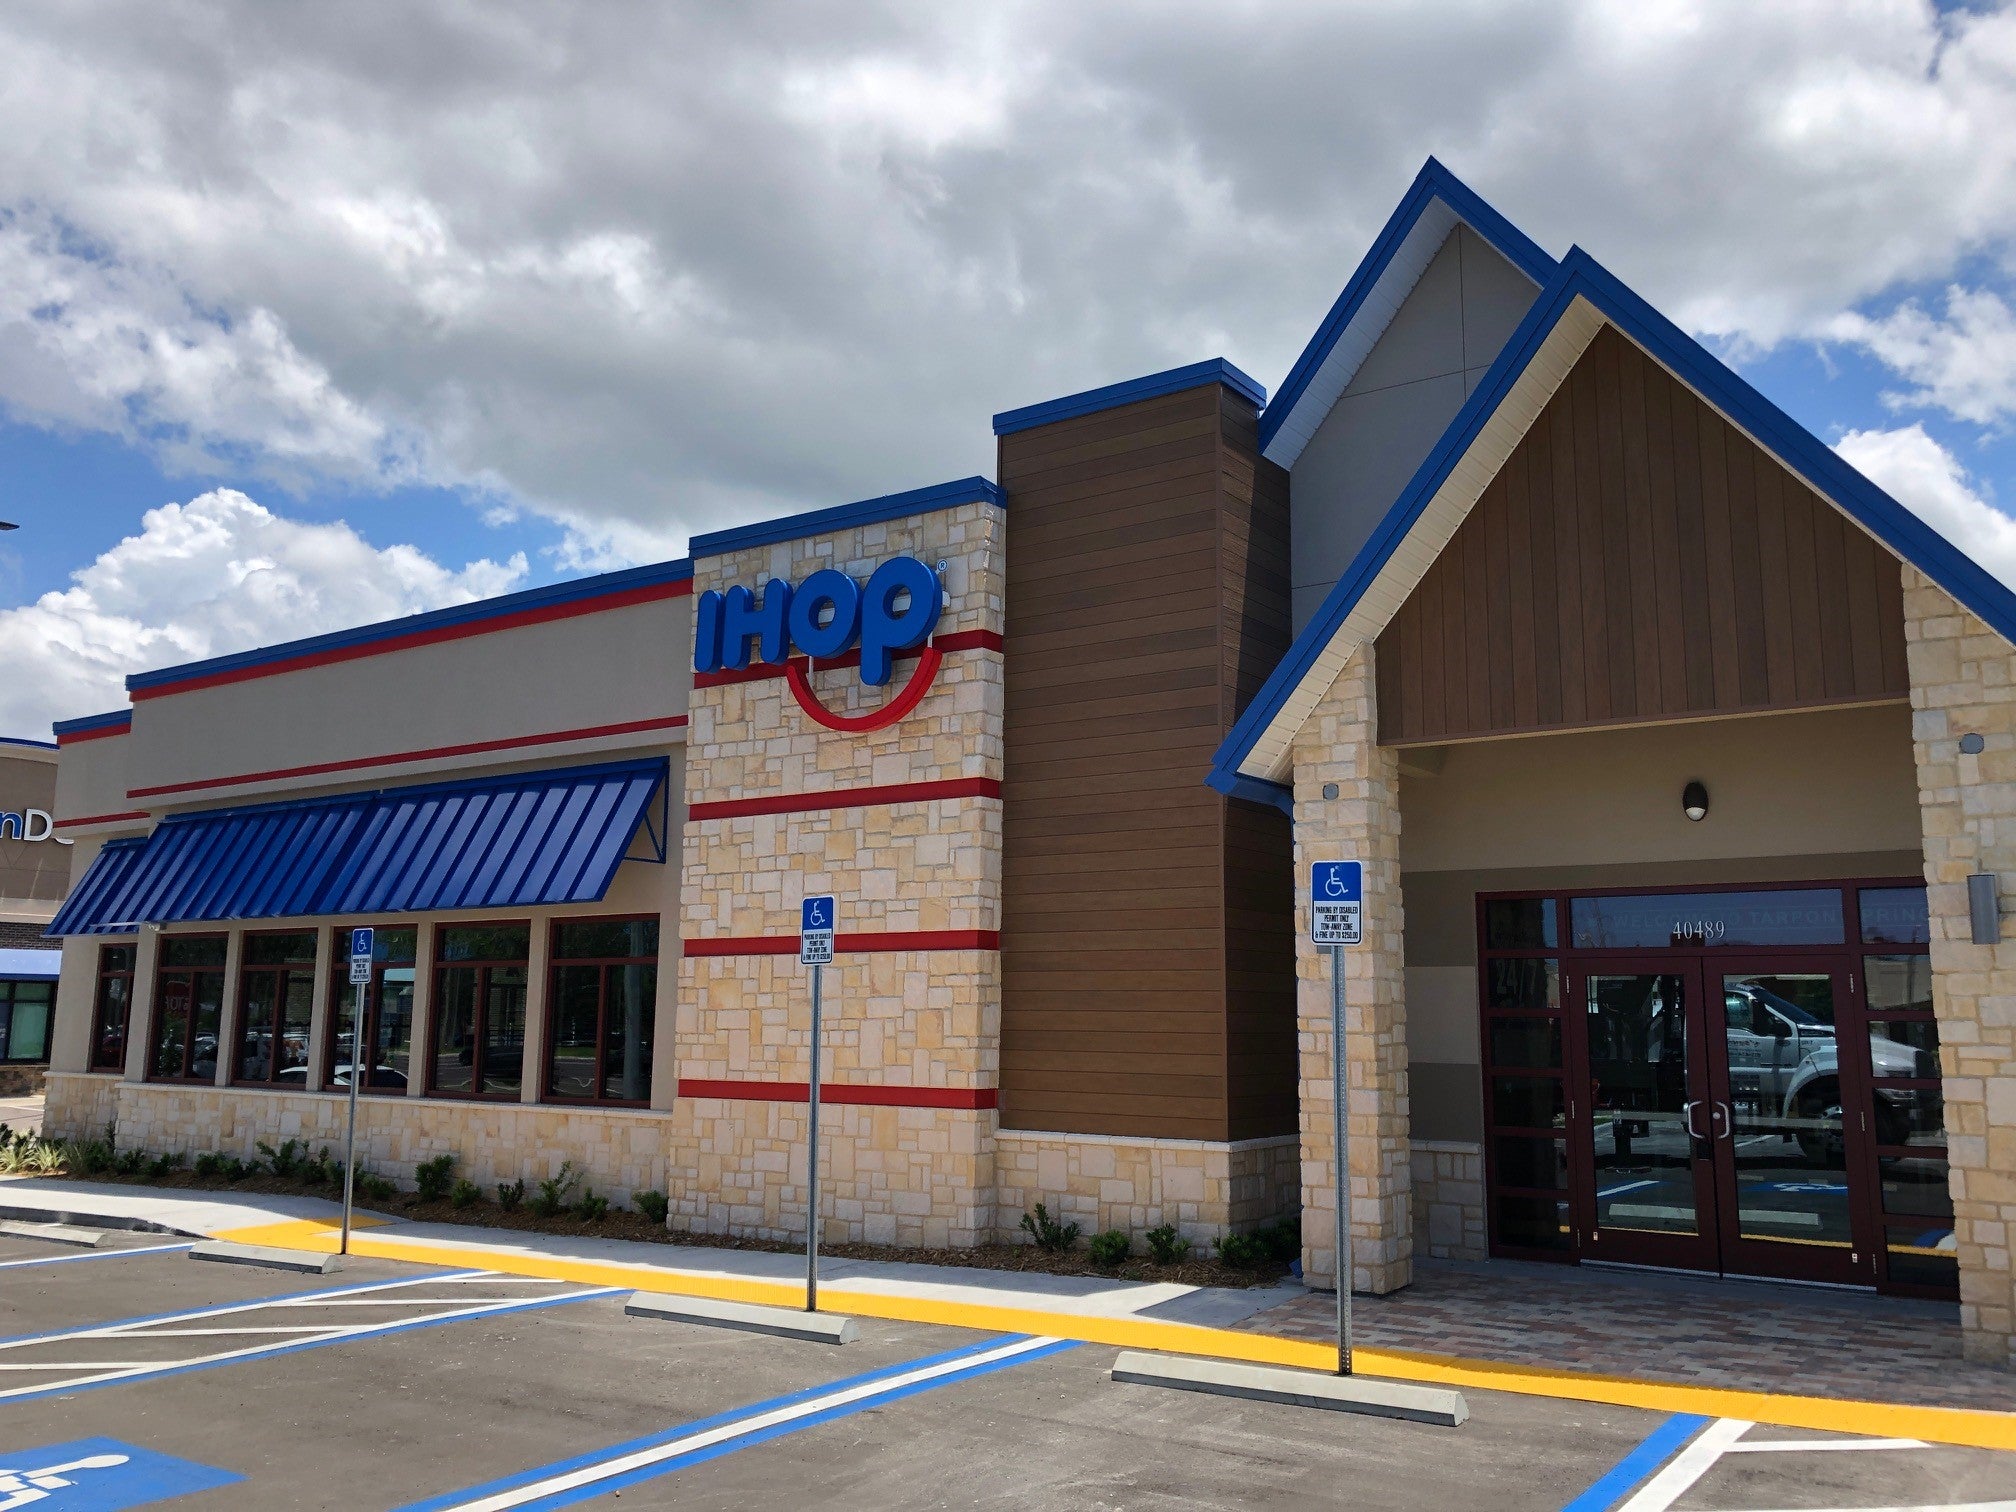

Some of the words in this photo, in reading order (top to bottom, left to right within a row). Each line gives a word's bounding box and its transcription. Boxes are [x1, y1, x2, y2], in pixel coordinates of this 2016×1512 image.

[0, 808, 75, 845] nD
[1339, 906, 1358, 914] DISABLED
[1672, 920, 1725, 940] 40489
